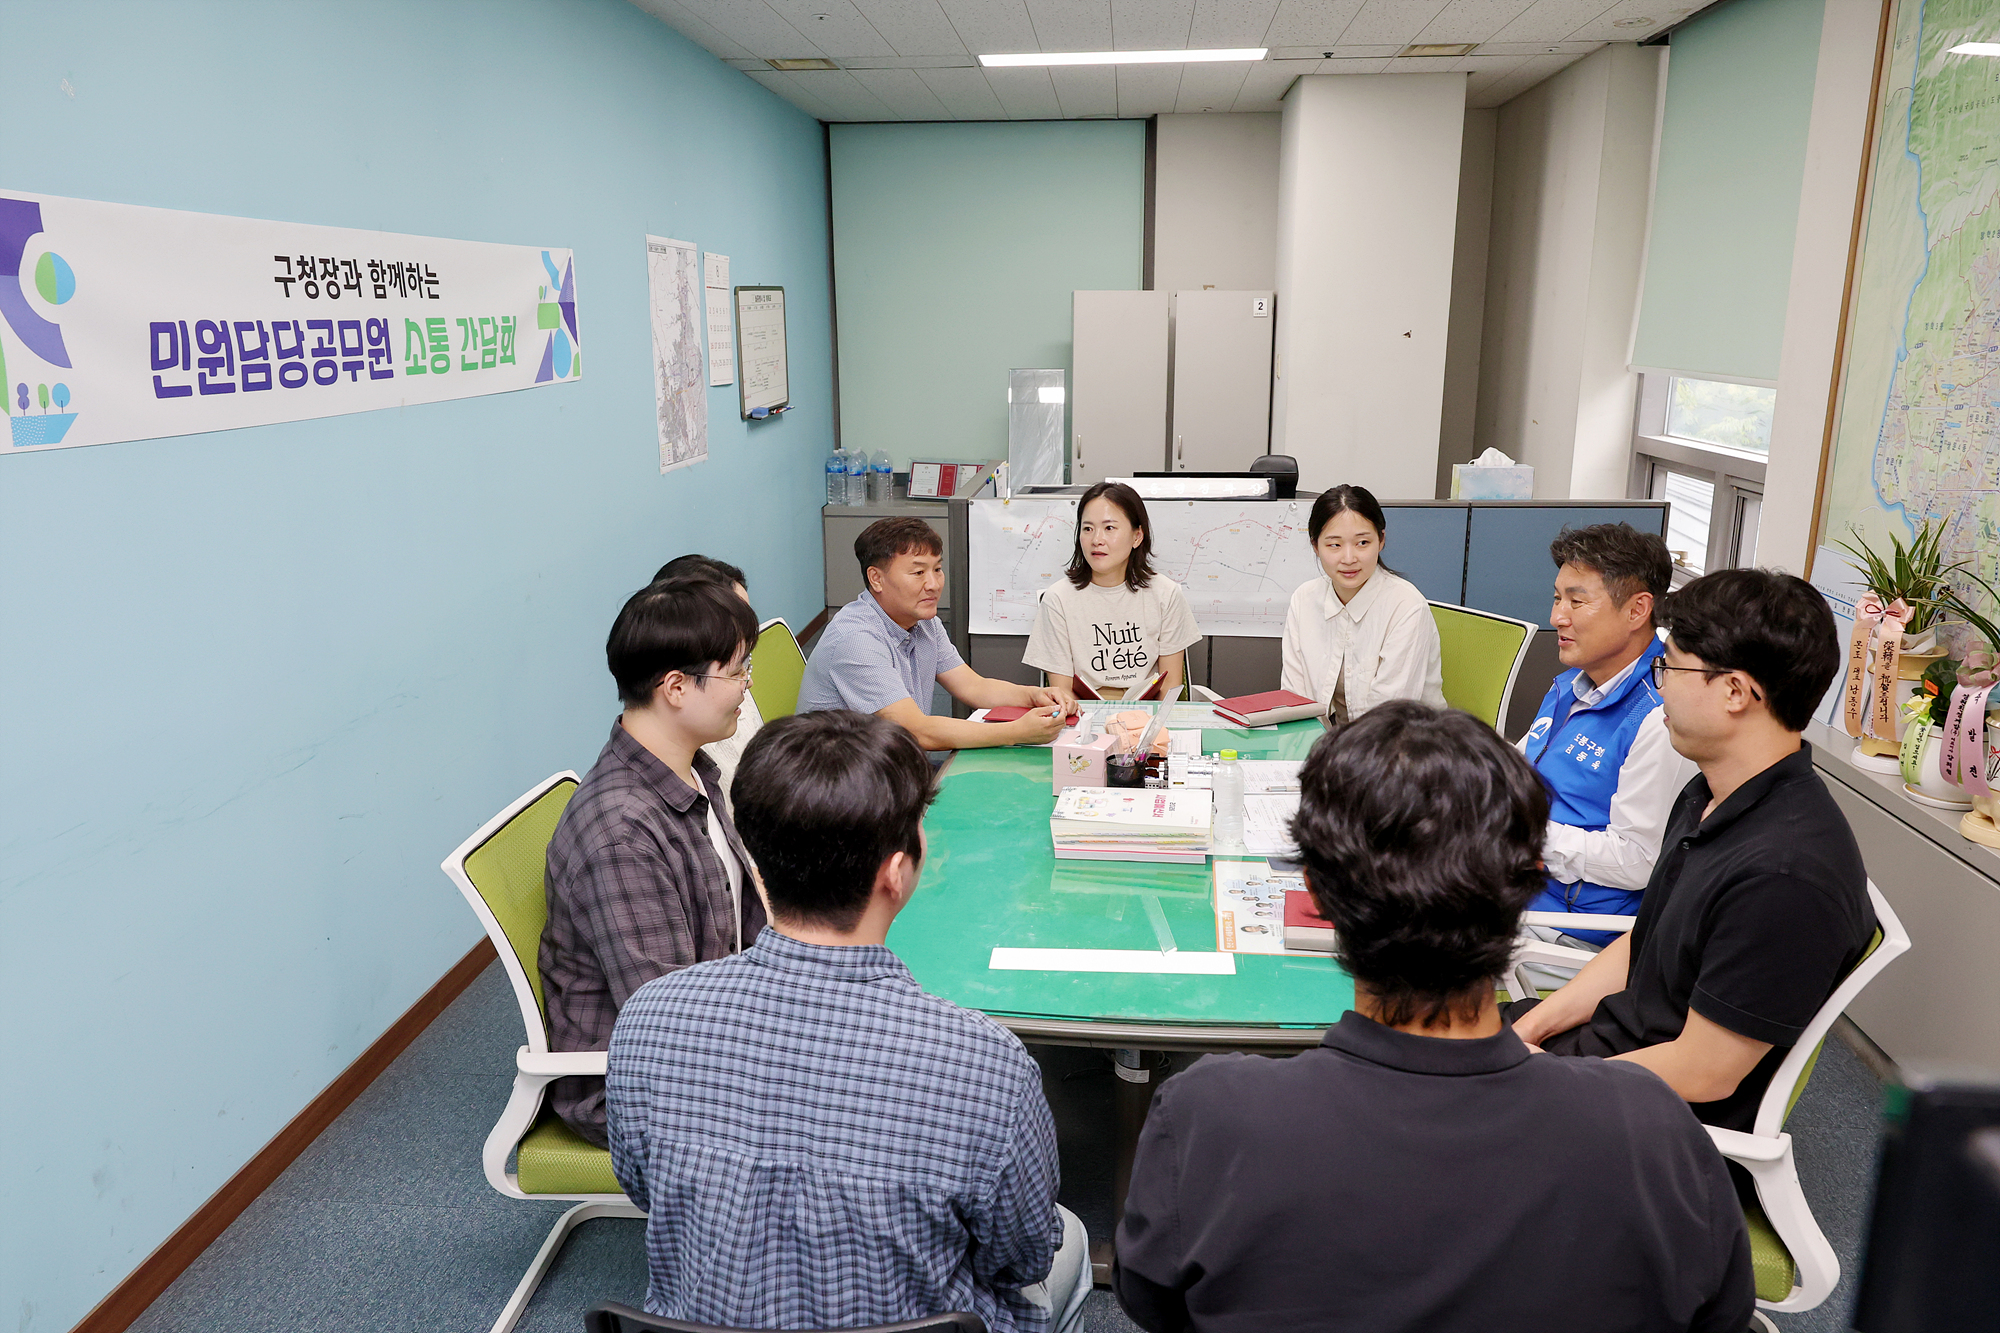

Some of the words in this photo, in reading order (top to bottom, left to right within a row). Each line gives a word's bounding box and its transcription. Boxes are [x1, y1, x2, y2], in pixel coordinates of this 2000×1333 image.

[273, 254, 363, 300] 구청장과
[367, 258, 440, 300] 함께하는
[1257, 301, 1264, 311] 2
[149, 317, 395, 399] 민원담당공무원
[404, 317, 451, 376] 소통
[456, 315, 517, 372] 간담회
[1091, 621, 1143, 646] Nuit
[1091, 645, 1148, 672] d'été
